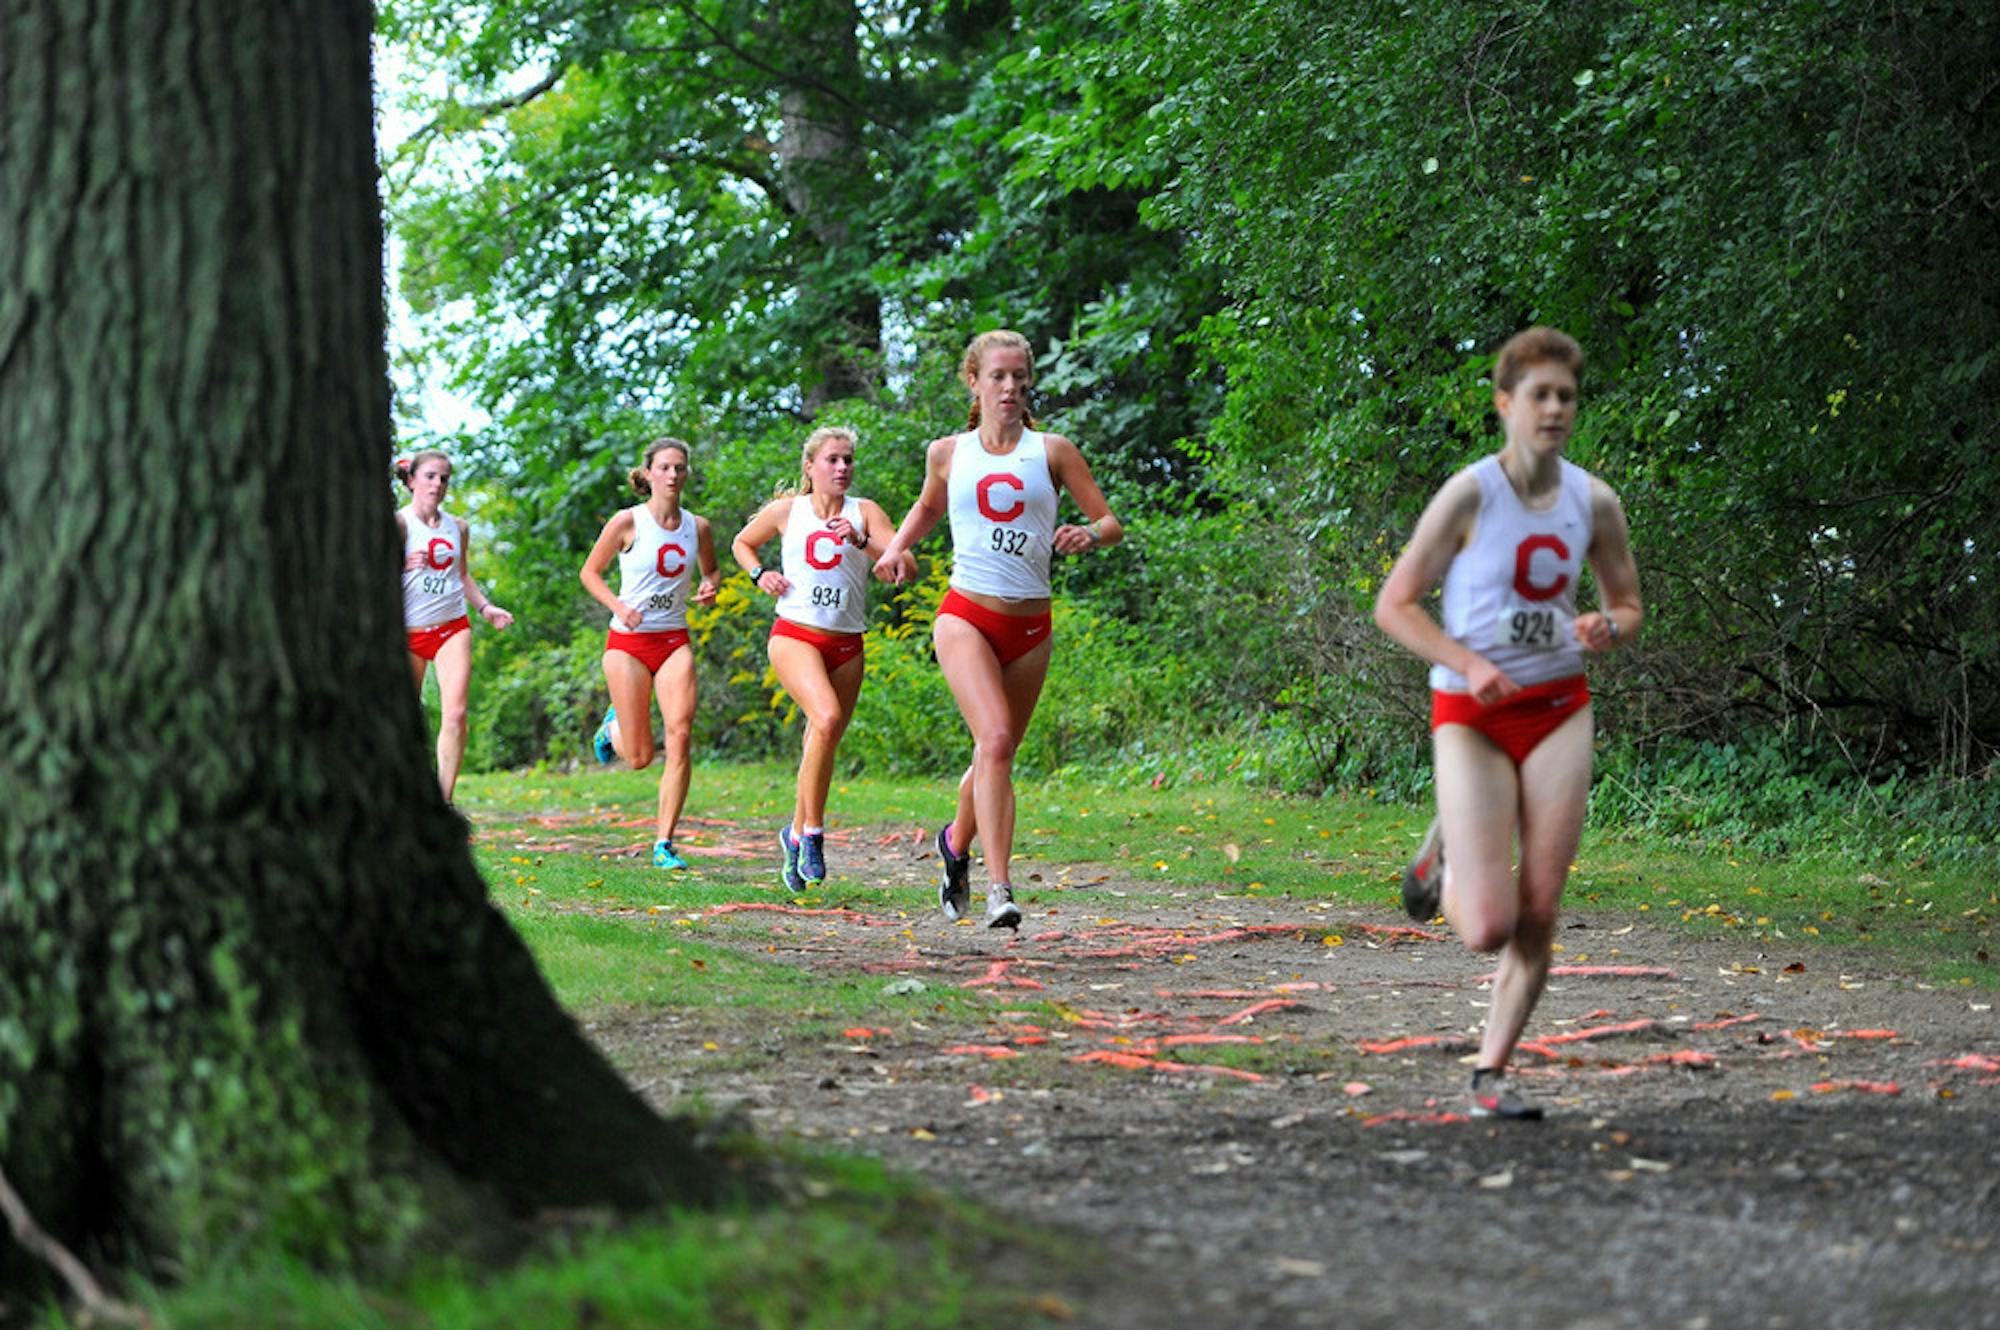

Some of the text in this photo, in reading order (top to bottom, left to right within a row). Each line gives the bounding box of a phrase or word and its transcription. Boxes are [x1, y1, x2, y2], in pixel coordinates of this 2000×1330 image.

[976, 473, 1025, 522] C
[428, 538, 454, 570] C
[806, 531, 843, 570] C
[991, 527, 1027, 556] 932
[656, 543, 686, 577] C
[1514, 534, 1570, 603] C
[811, 585, 841, 608] 934
[1511, 611, 1554, 644] 924
